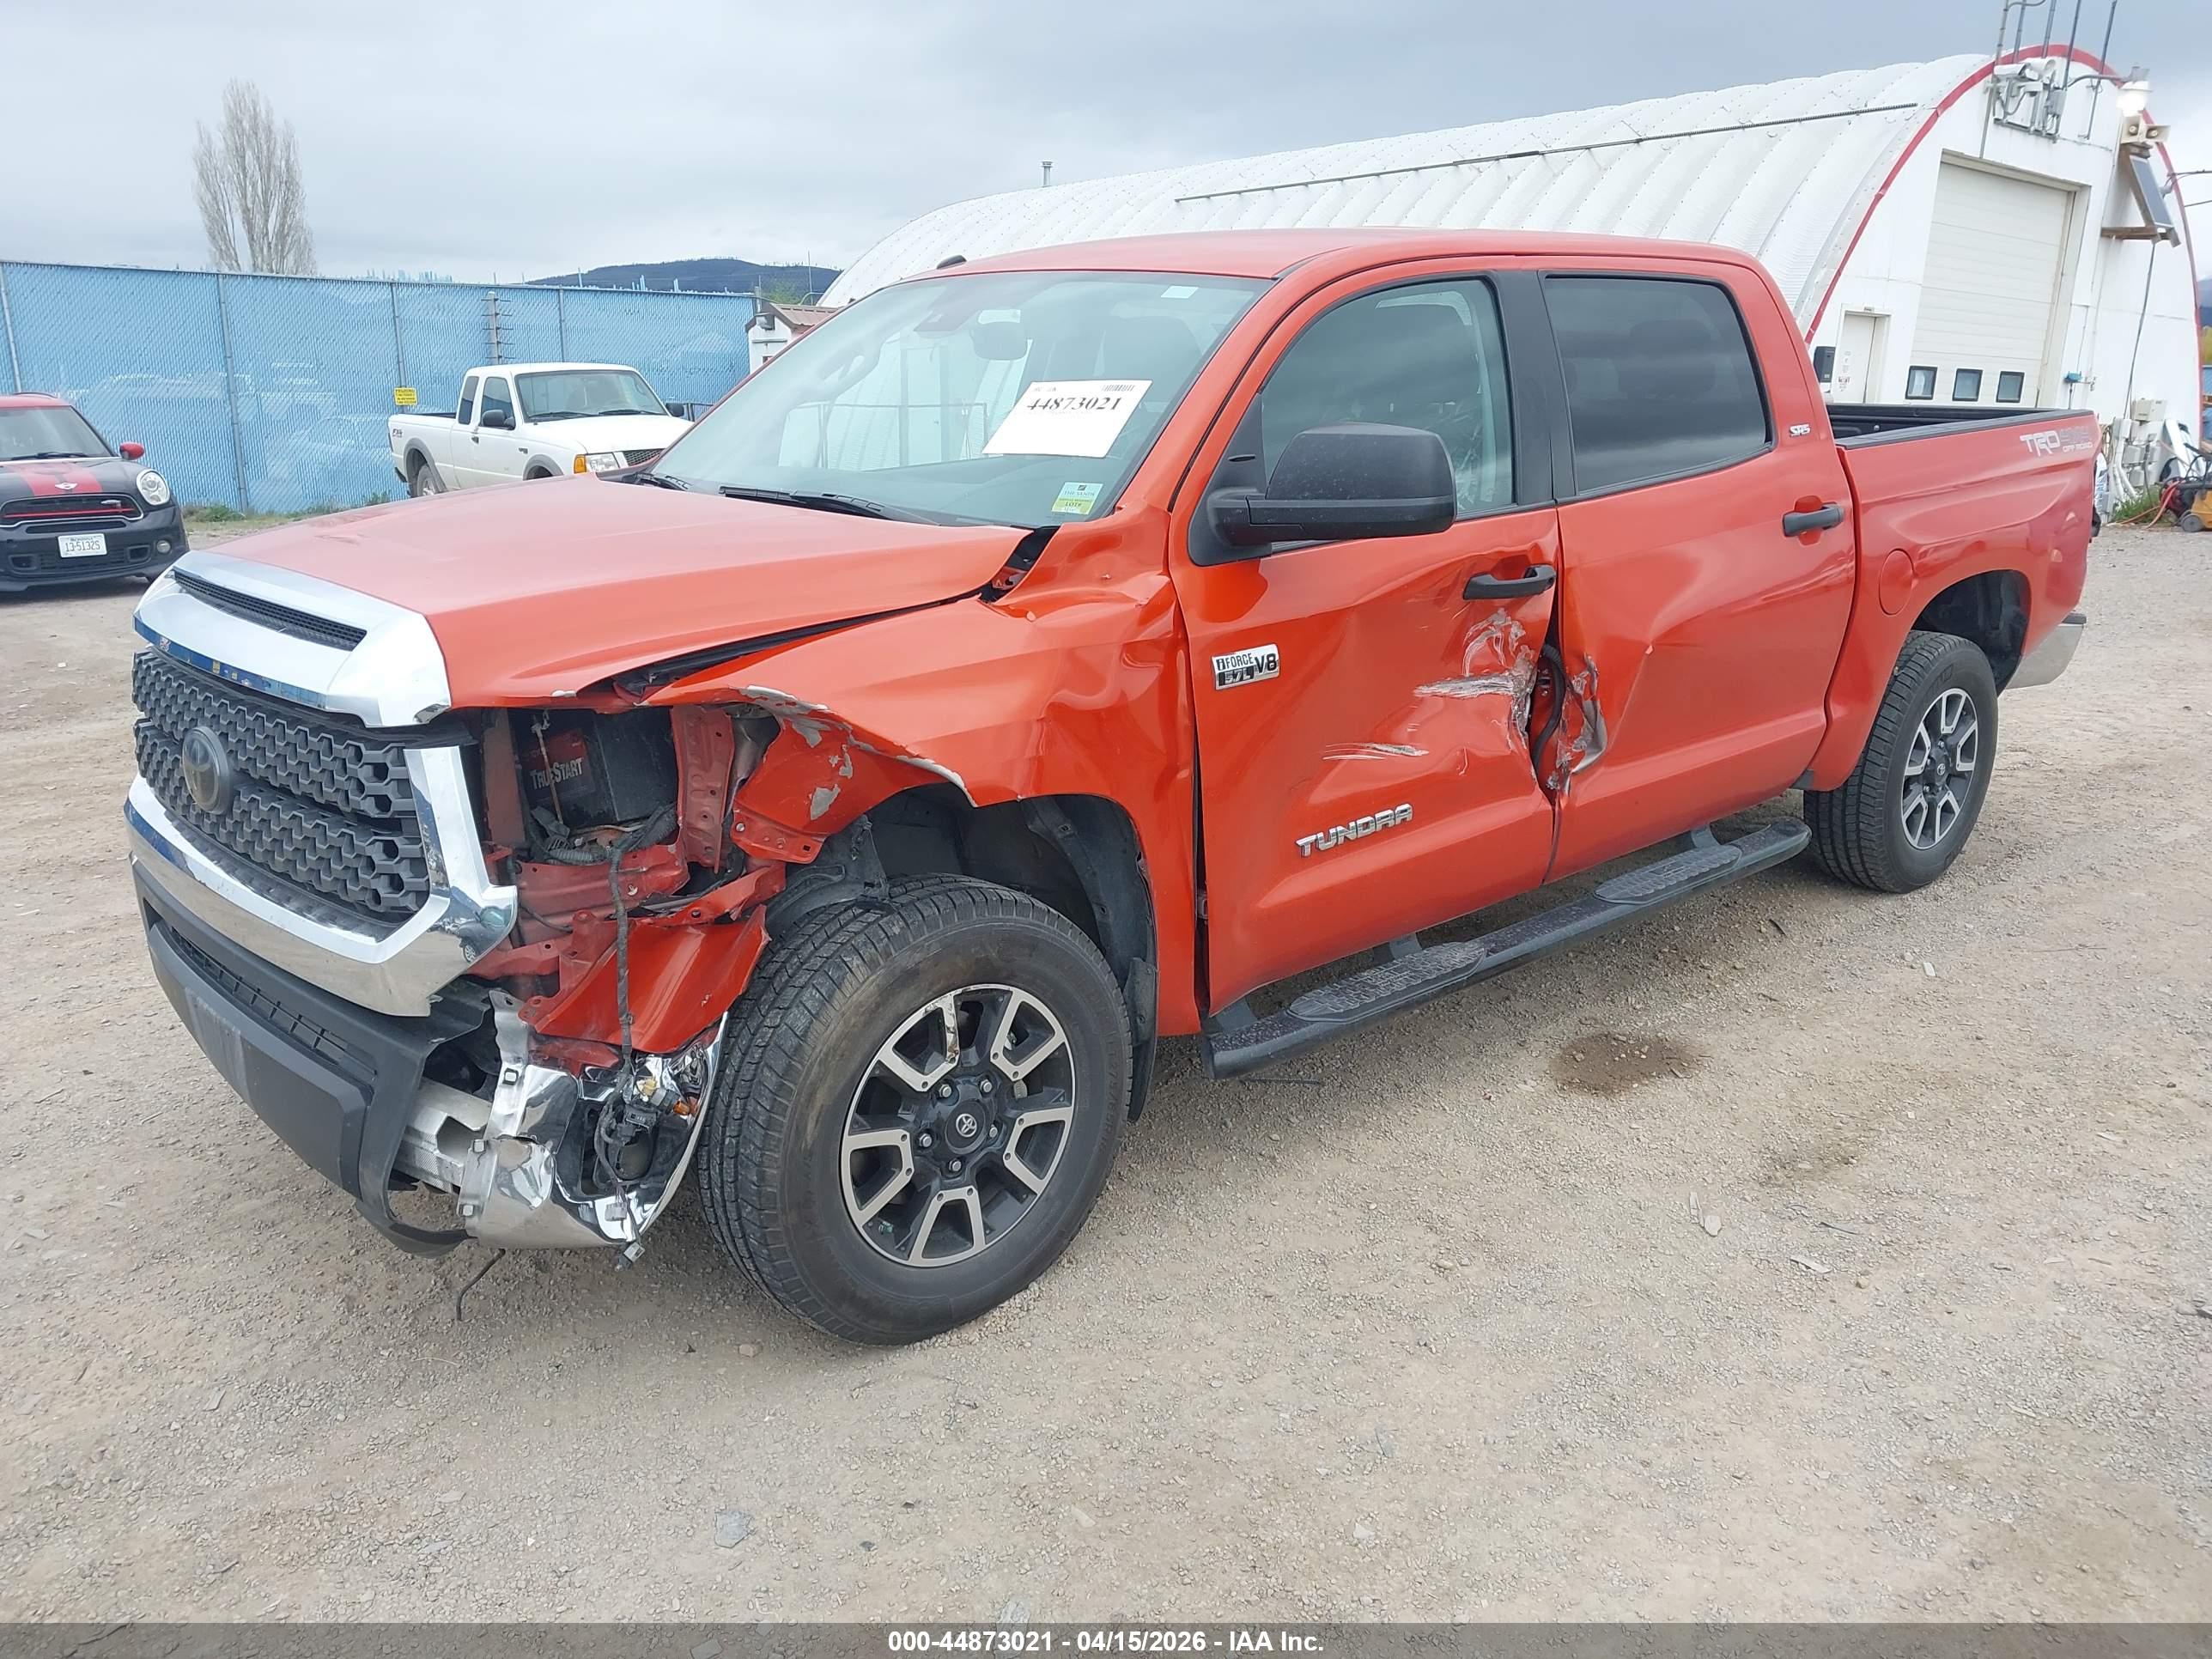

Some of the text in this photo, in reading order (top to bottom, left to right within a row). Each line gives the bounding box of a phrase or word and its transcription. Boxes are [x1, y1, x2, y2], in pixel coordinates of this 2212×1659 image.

[1026, 397, 1123, 411] 44873021
[1255, 653, 1278, 673] V8
[1295, 803, 1413, 857] TUNDRA
